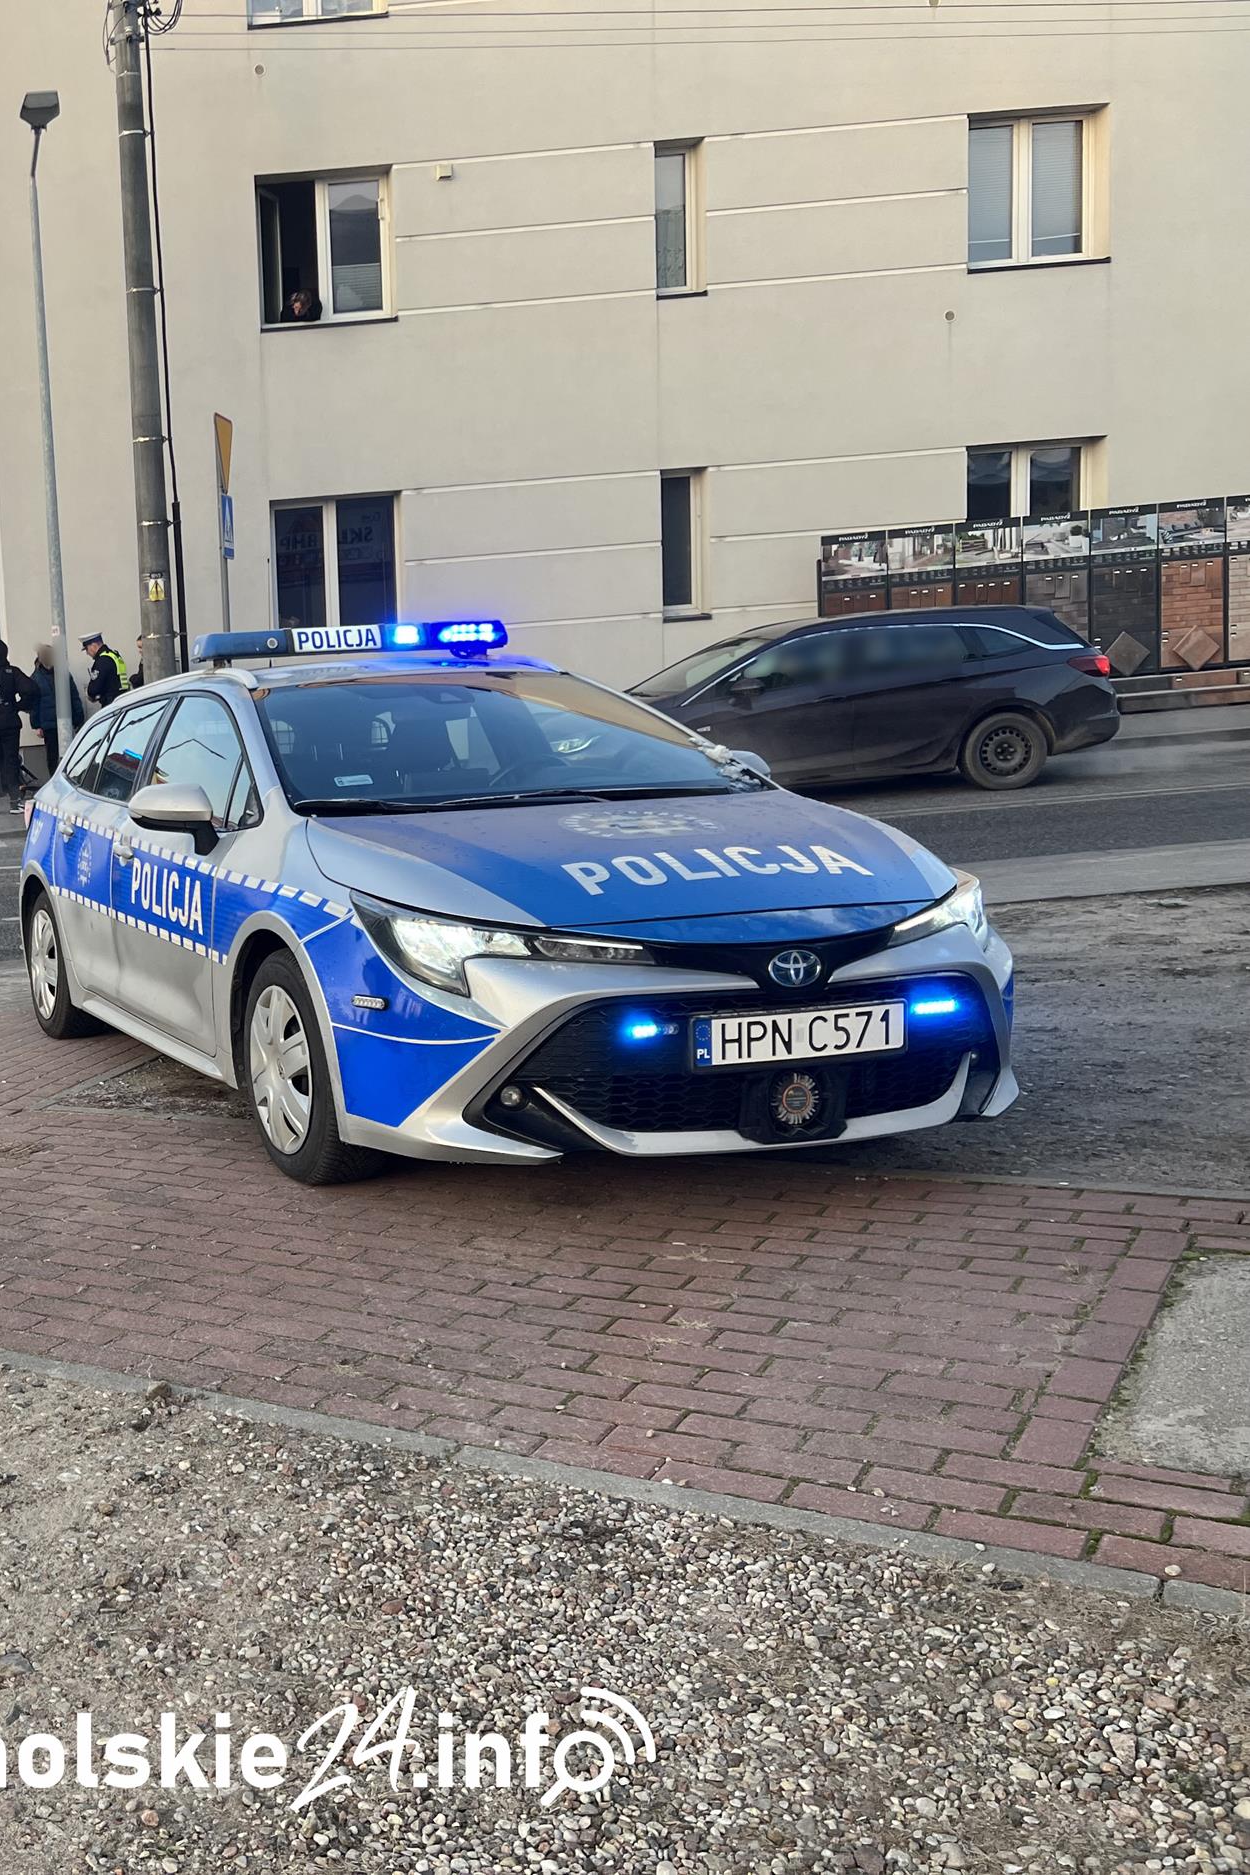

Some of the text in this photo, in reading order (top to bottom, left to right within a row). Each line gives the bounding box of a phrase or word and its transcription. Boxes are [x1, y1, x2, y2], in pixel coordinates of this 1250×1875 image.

[297, 628, 378, 650] POLICJA
[561, 845, 875, 896] POLICJA
[131, 857, 204, 936] POLICJA
[696, 1048, 710, 1059] PL
[720, 1008, 891, 1060] HPN C571
